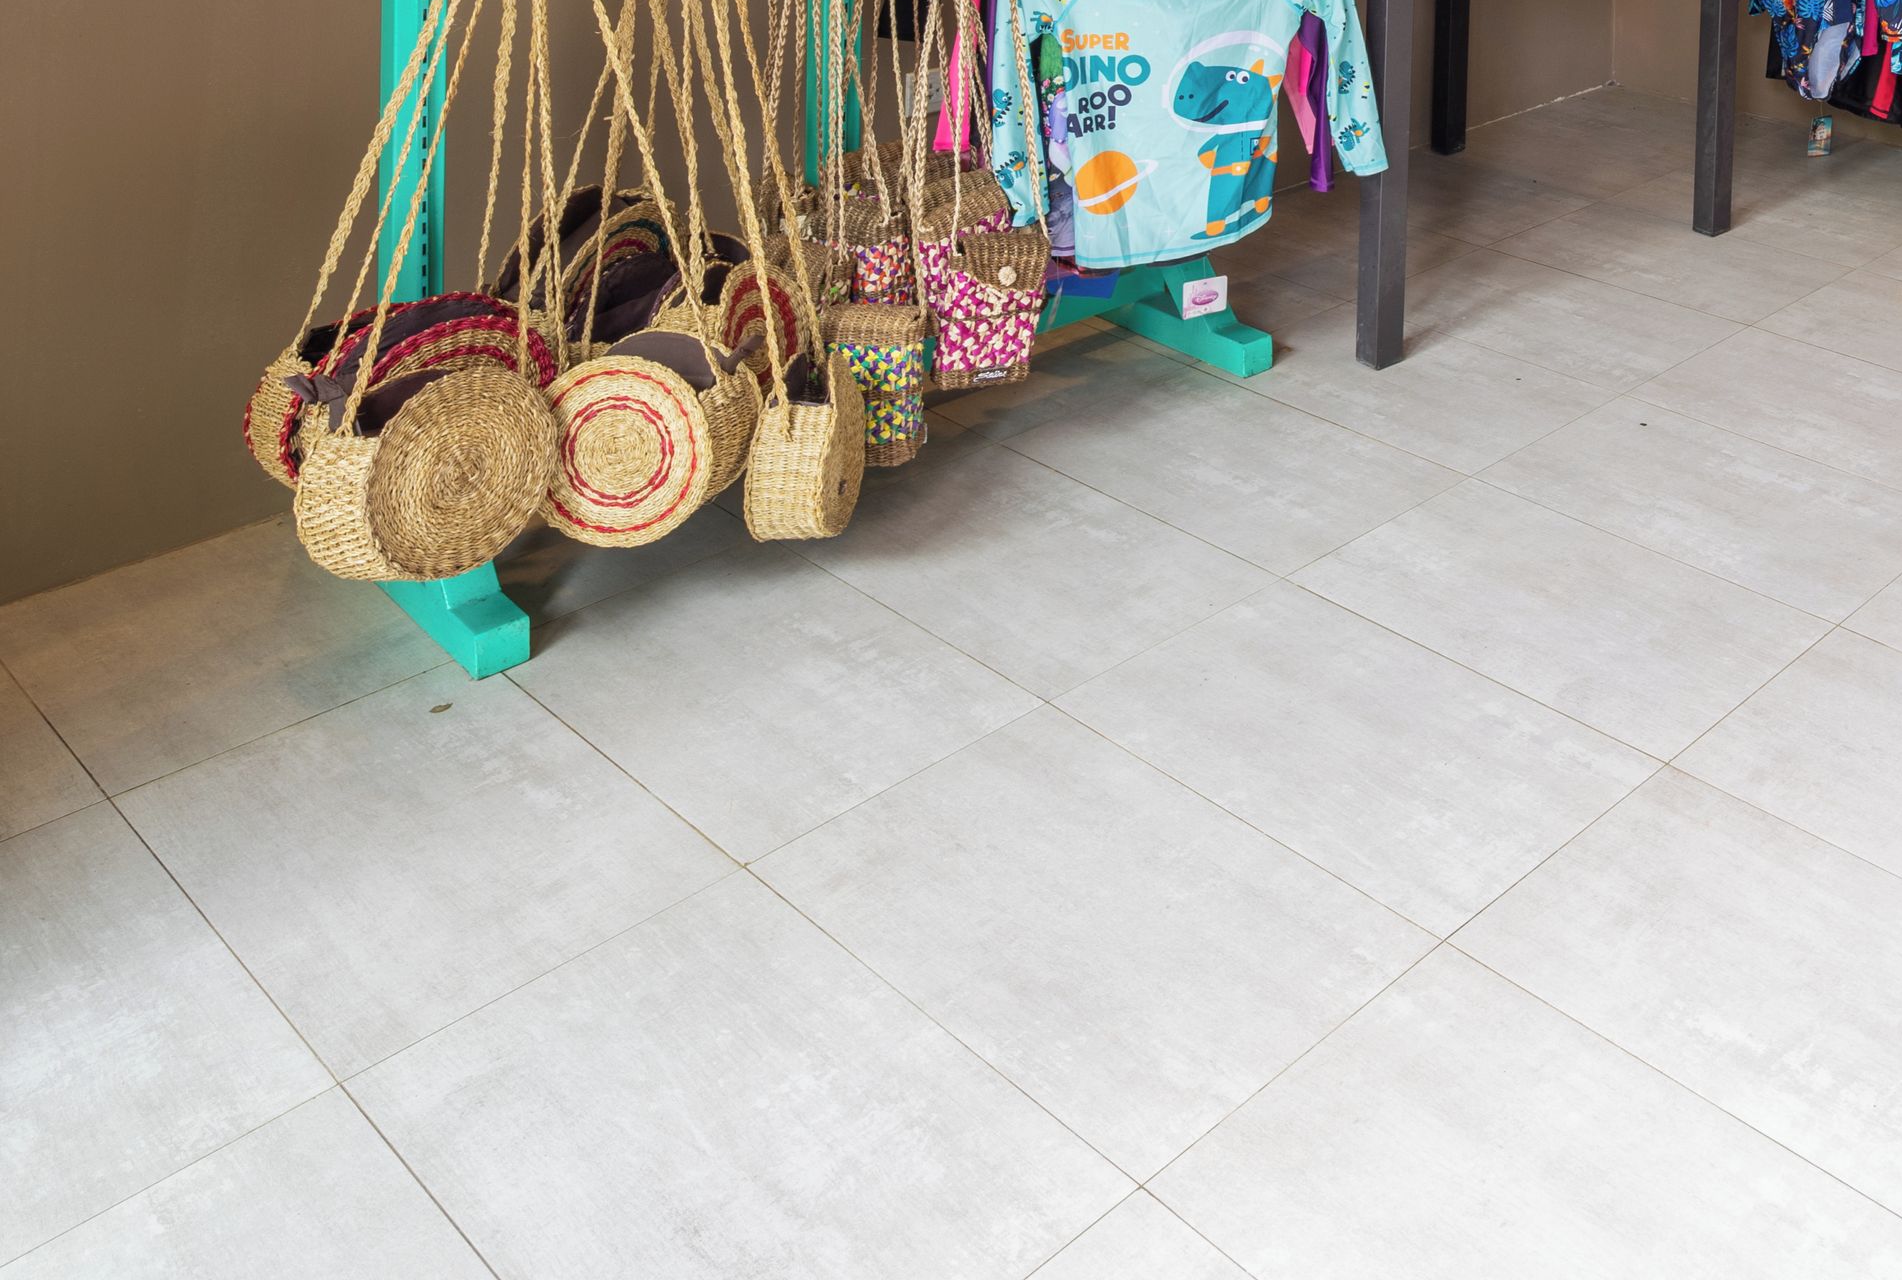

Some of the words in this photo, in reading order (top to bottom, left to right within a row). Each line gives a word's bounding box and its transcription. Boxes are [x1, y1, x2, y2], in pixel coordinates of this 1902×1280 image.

[1061, 28, 1130, 53] SUPER
[1062, 54, 1151, 92] DINO
[1078, 84, 1132, 115] ROO
[1066, 106, 1116, 139] ARR!
